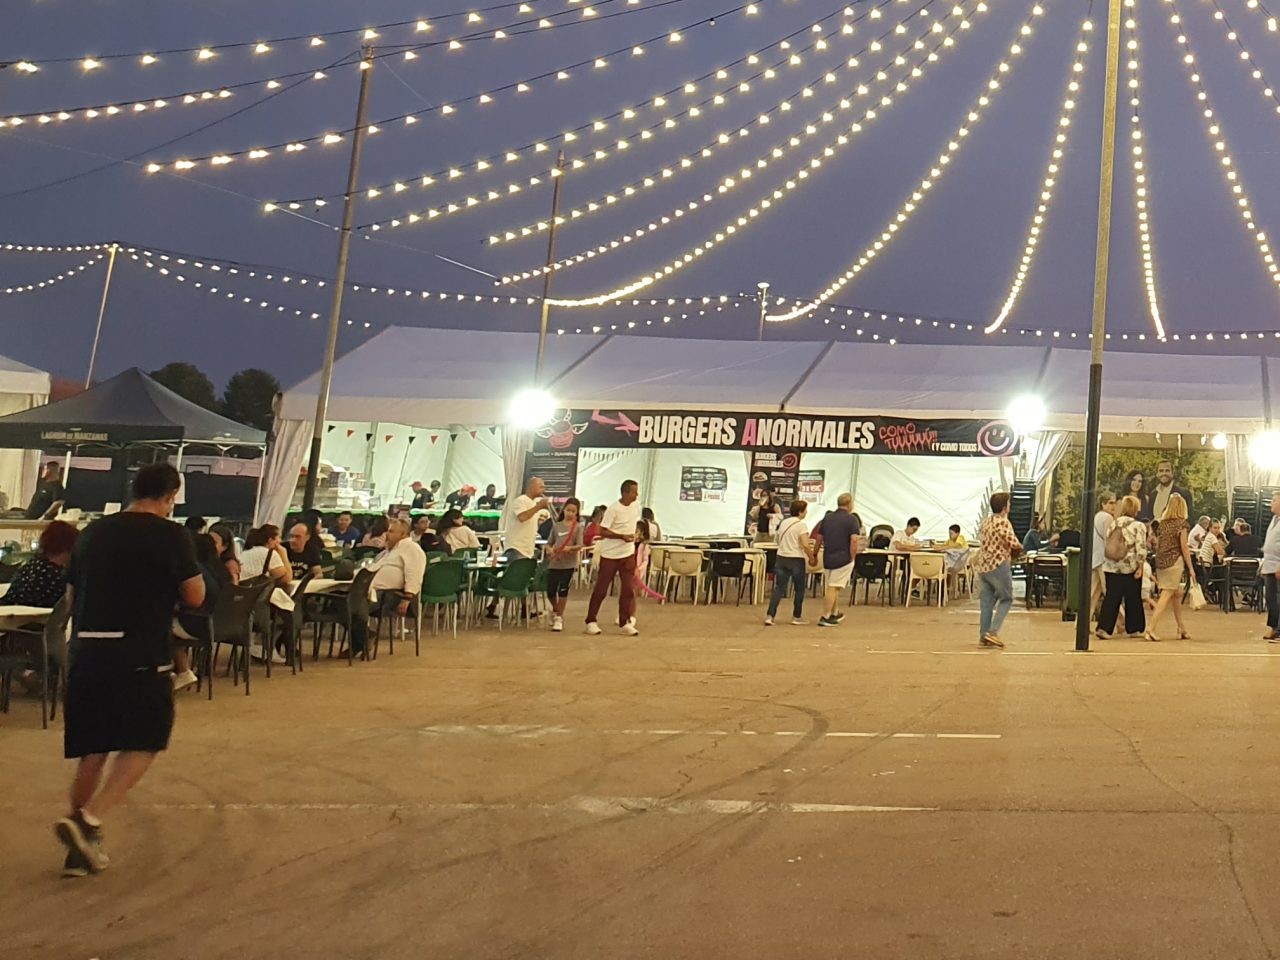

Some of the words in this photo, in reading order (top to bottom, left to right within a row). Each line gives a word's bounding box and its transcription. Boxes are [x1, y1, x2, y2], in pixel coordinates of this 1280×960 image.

[638, 415, 737, 446] BURGERS
[742, 419, 875, 450] ANORMALES
[879, 422, 916, 440] COMO
